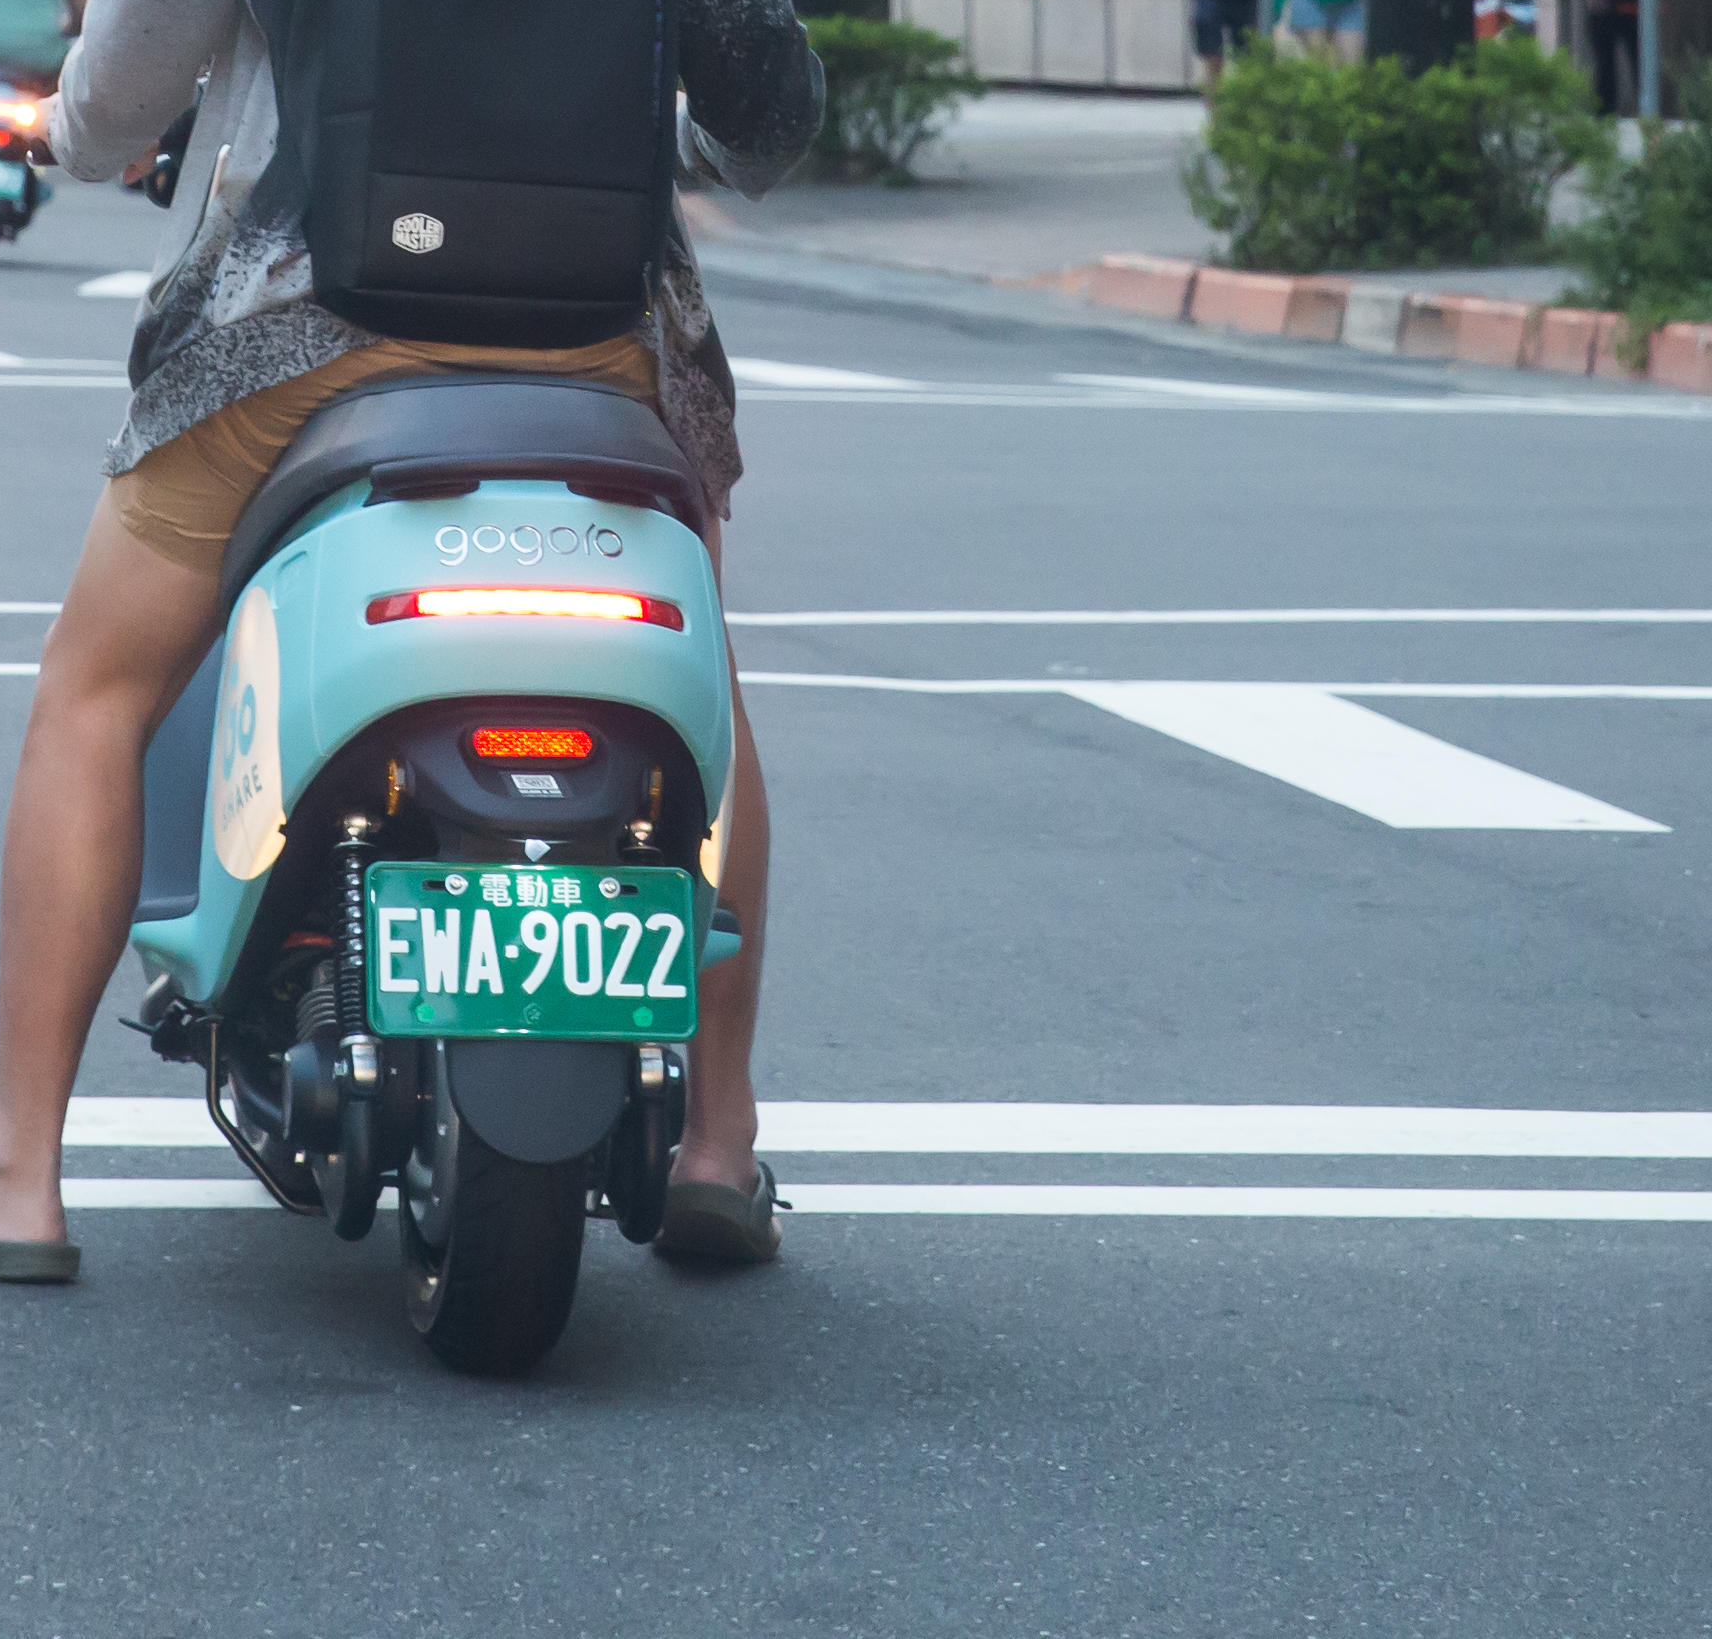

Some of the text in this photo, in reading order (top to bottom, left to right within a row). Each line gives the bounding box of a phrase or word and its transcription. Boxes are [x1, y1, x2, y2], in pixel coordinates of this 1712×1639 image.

[434, 522, 624, 566] gogoro
[479, 873, 583, 908] 電動車
